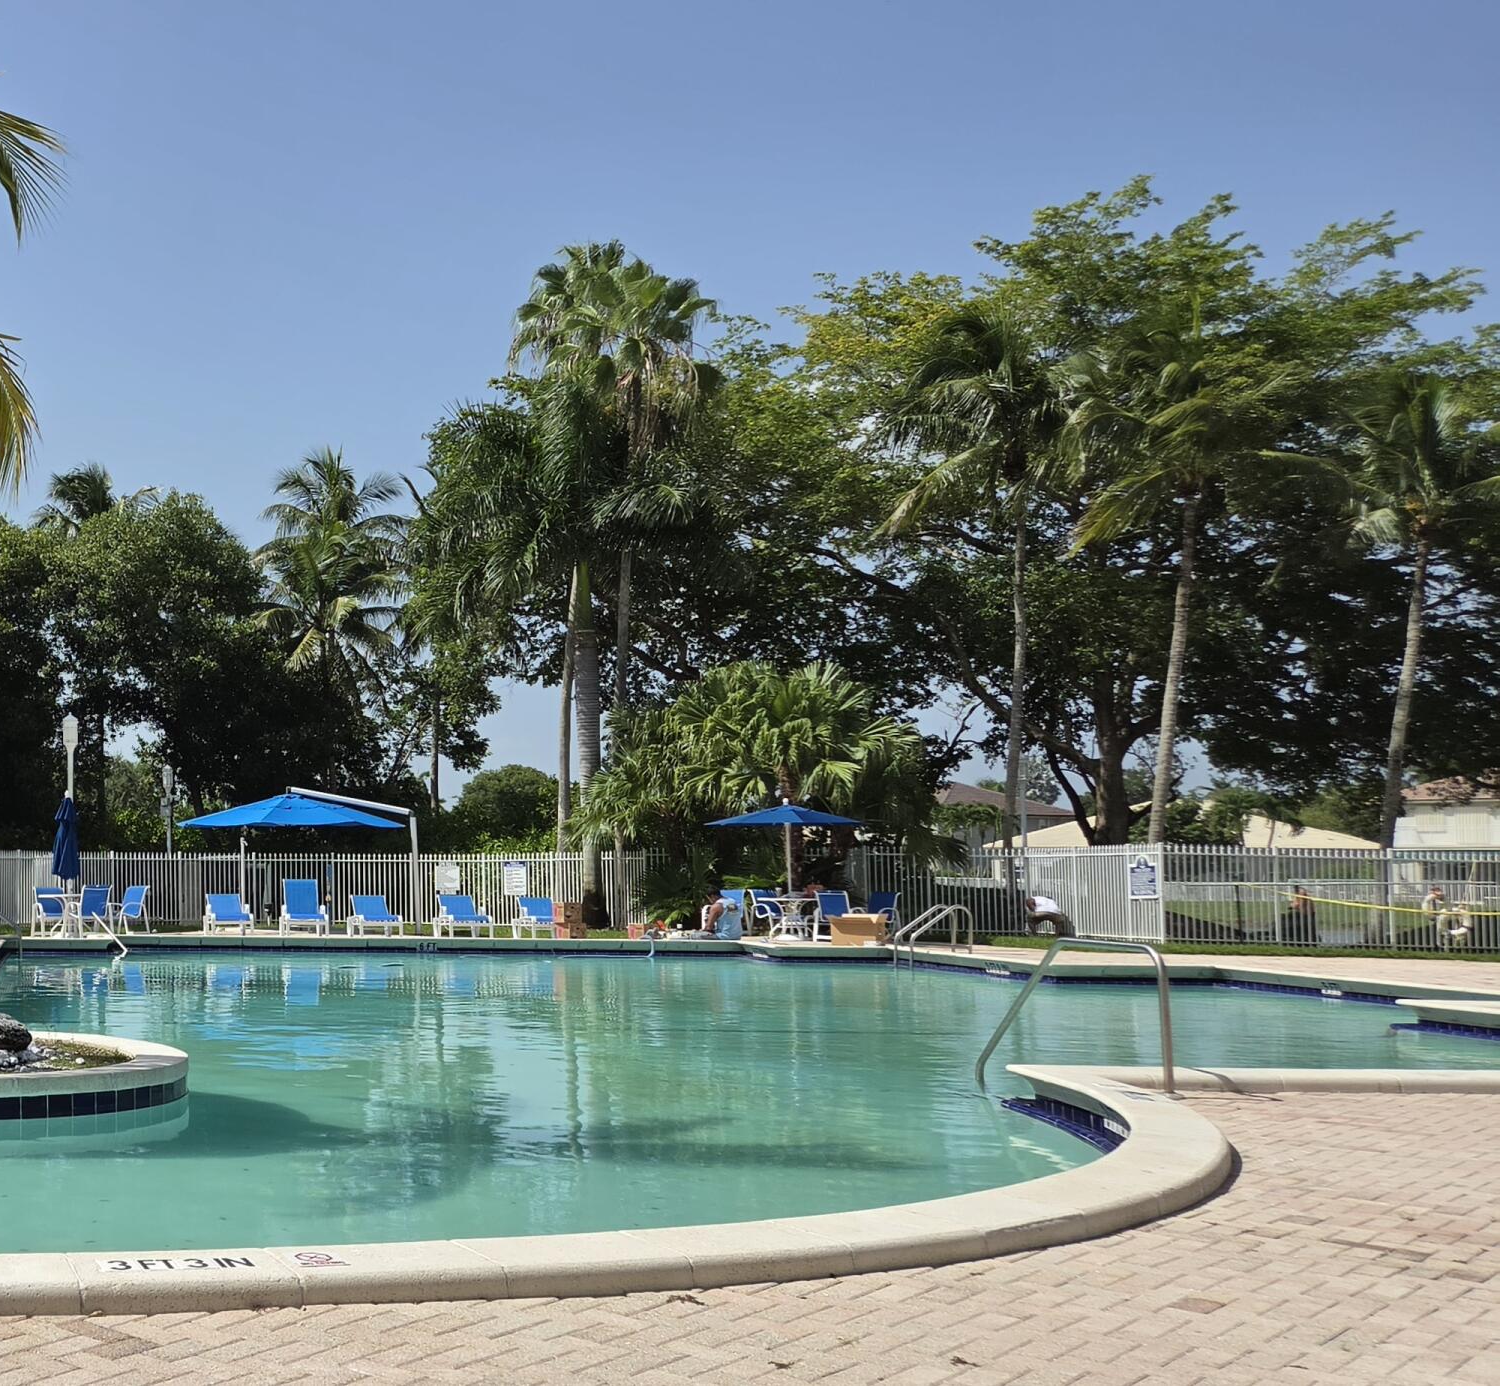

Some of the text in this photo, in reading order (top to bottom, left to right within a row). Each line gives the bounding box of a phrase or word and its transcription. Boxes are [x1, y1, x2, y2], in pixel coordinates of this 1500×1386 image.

[427, 942, 437, 951] FT
[107, 1257, 256, 1271] 3 FT 3 IN
